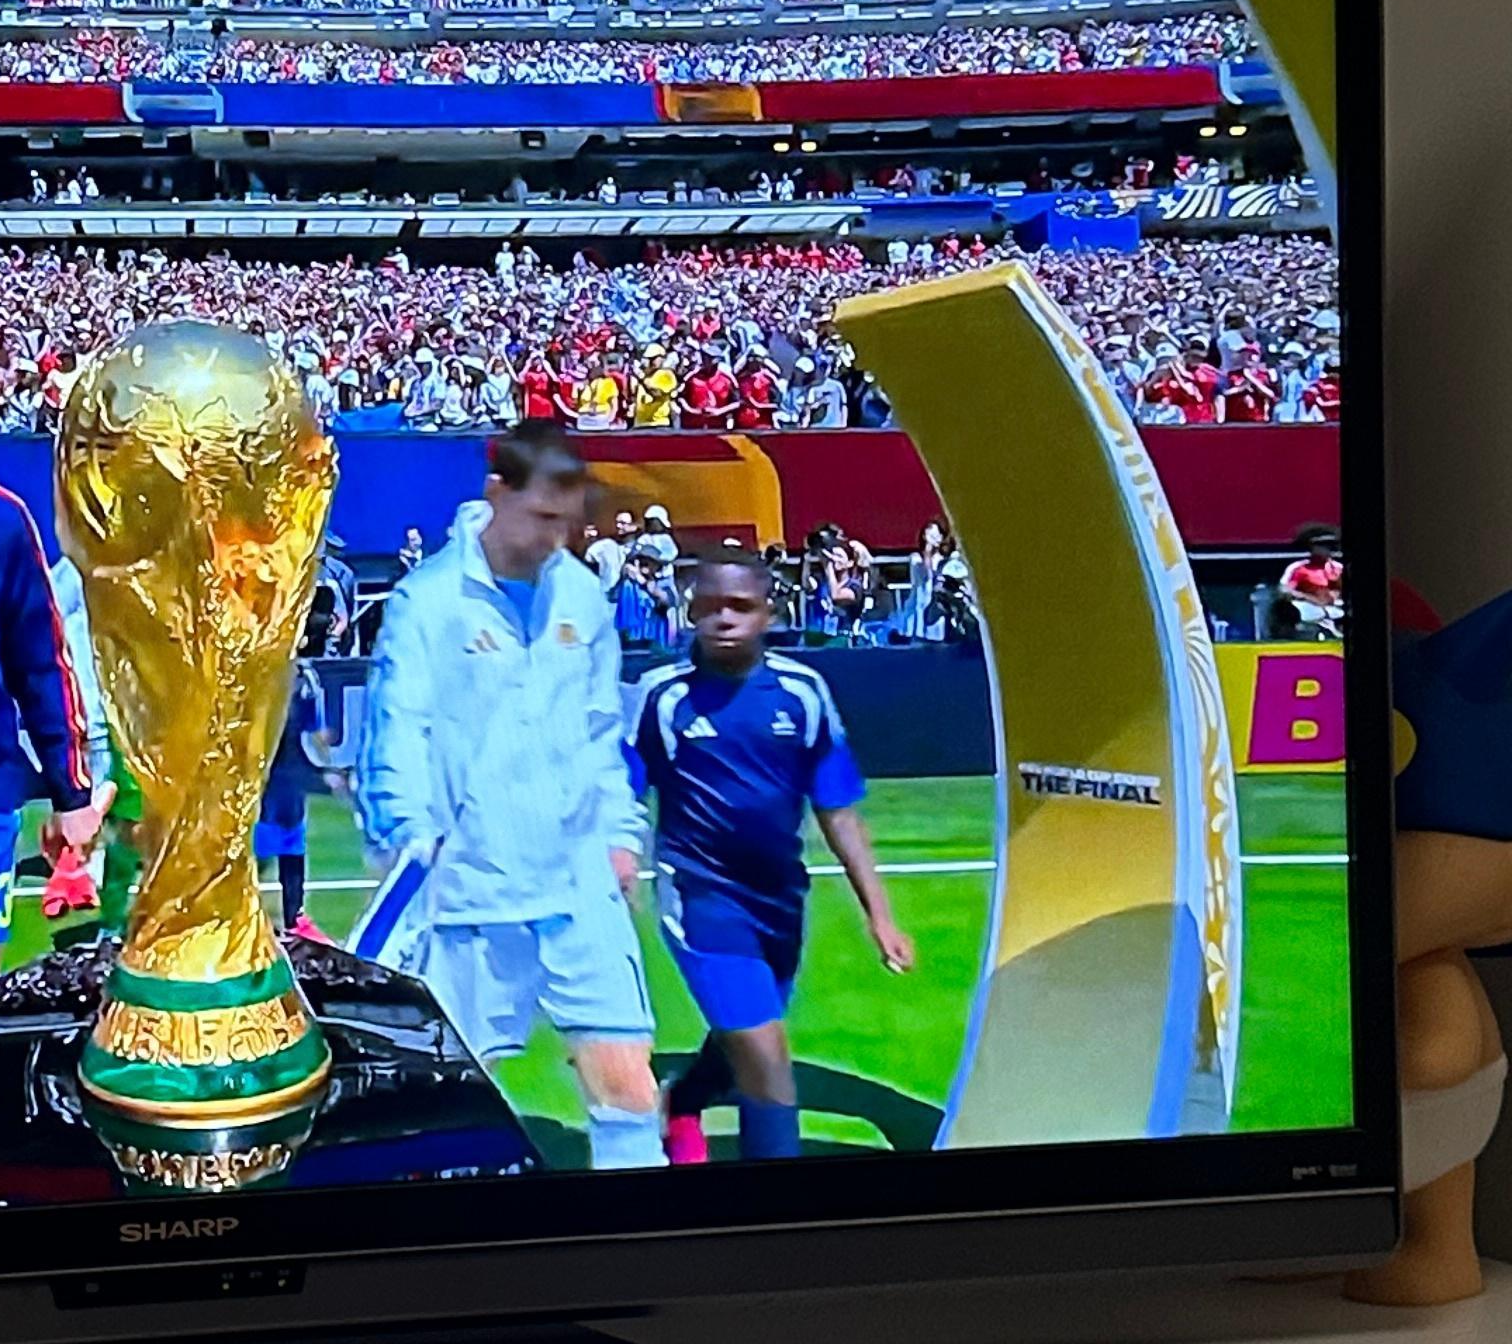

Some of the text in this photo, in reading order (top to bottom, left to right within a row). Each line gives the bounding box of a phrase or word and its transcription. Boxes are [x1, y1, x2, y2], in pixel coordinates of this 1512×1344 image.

[1020, 772, 1071, 795] THE
[1074, 778, 1162, 806] FINAL
[119, 1216, 240, 1243] SHARP
